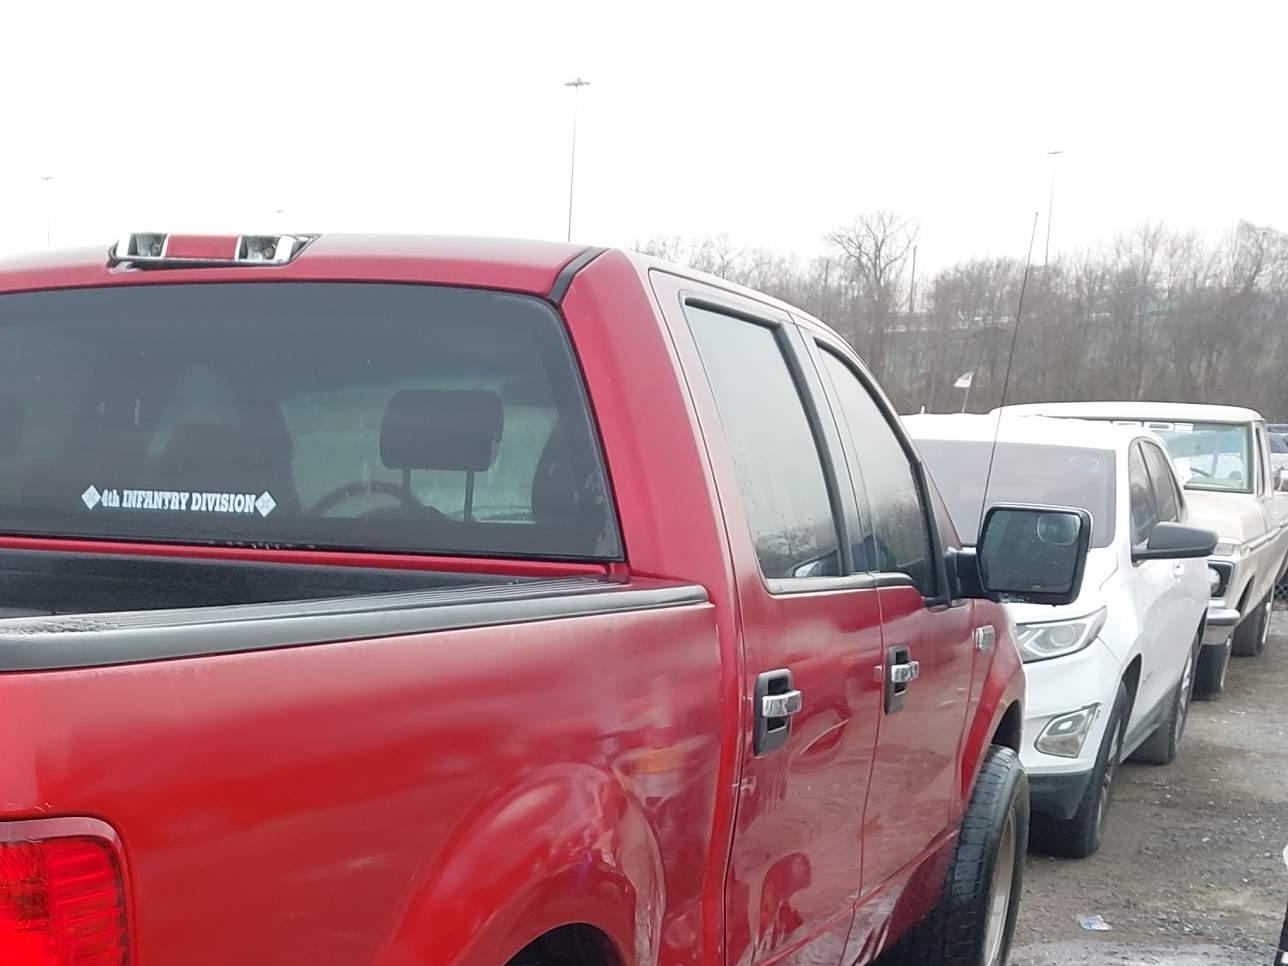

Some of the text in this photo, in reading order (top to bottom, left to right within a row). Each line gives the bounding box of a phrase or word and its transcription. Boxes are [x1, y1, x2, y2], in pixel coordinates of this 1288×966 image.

[101, 489, 256, 513] 4th INFANTRY DIVISION
